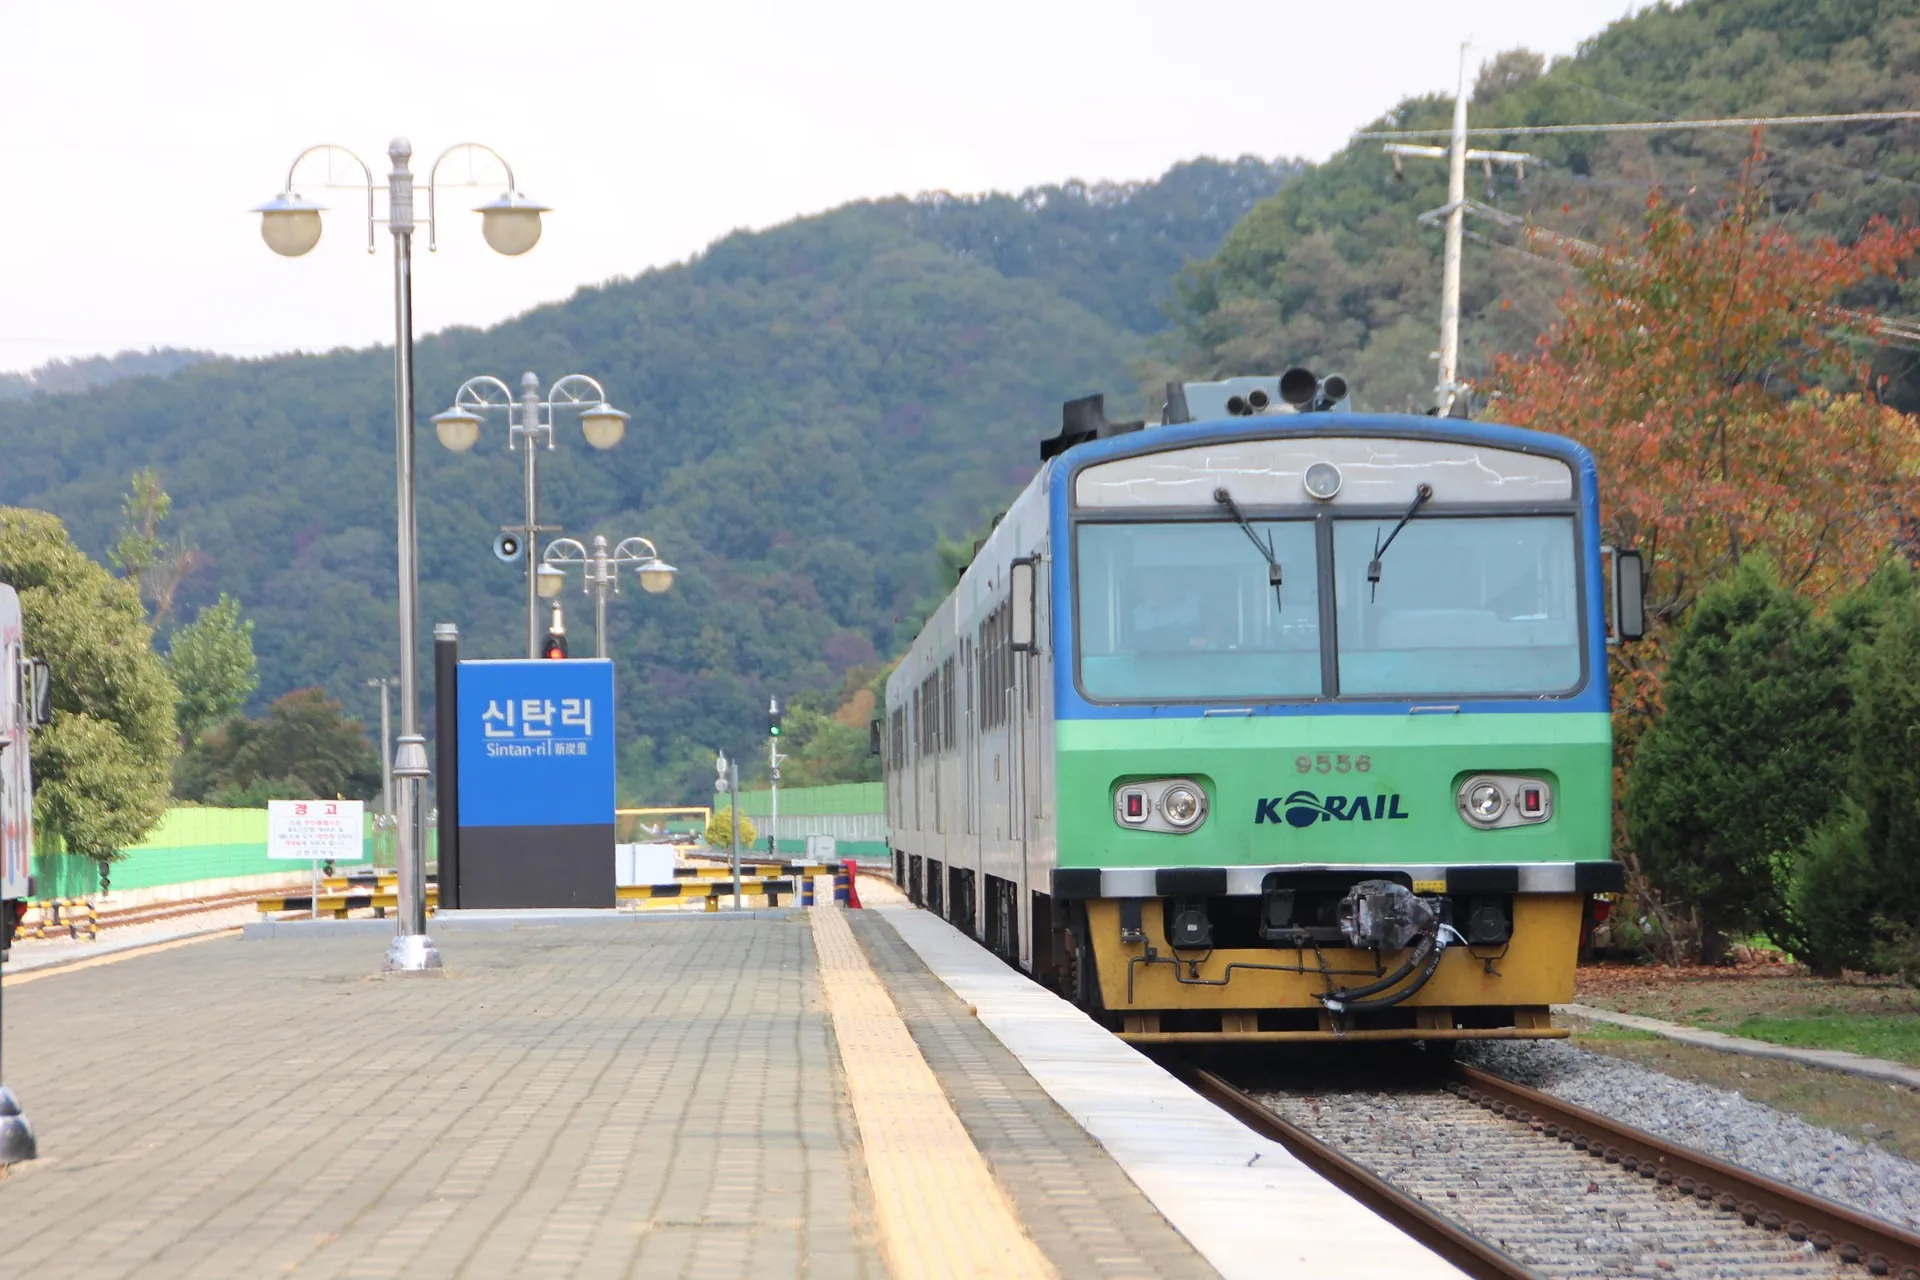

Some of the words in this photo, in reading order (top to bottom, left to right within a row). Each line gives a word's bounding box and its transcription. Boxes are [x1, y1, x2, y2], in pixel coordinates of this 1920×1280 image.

[482, 699, 592, 737] 신탄리
[486, 742, 546, 757] Sintan-ri
[1295, 754, 1372, 774] 9556
[1255, 790, 1409, 828] KORAIL
